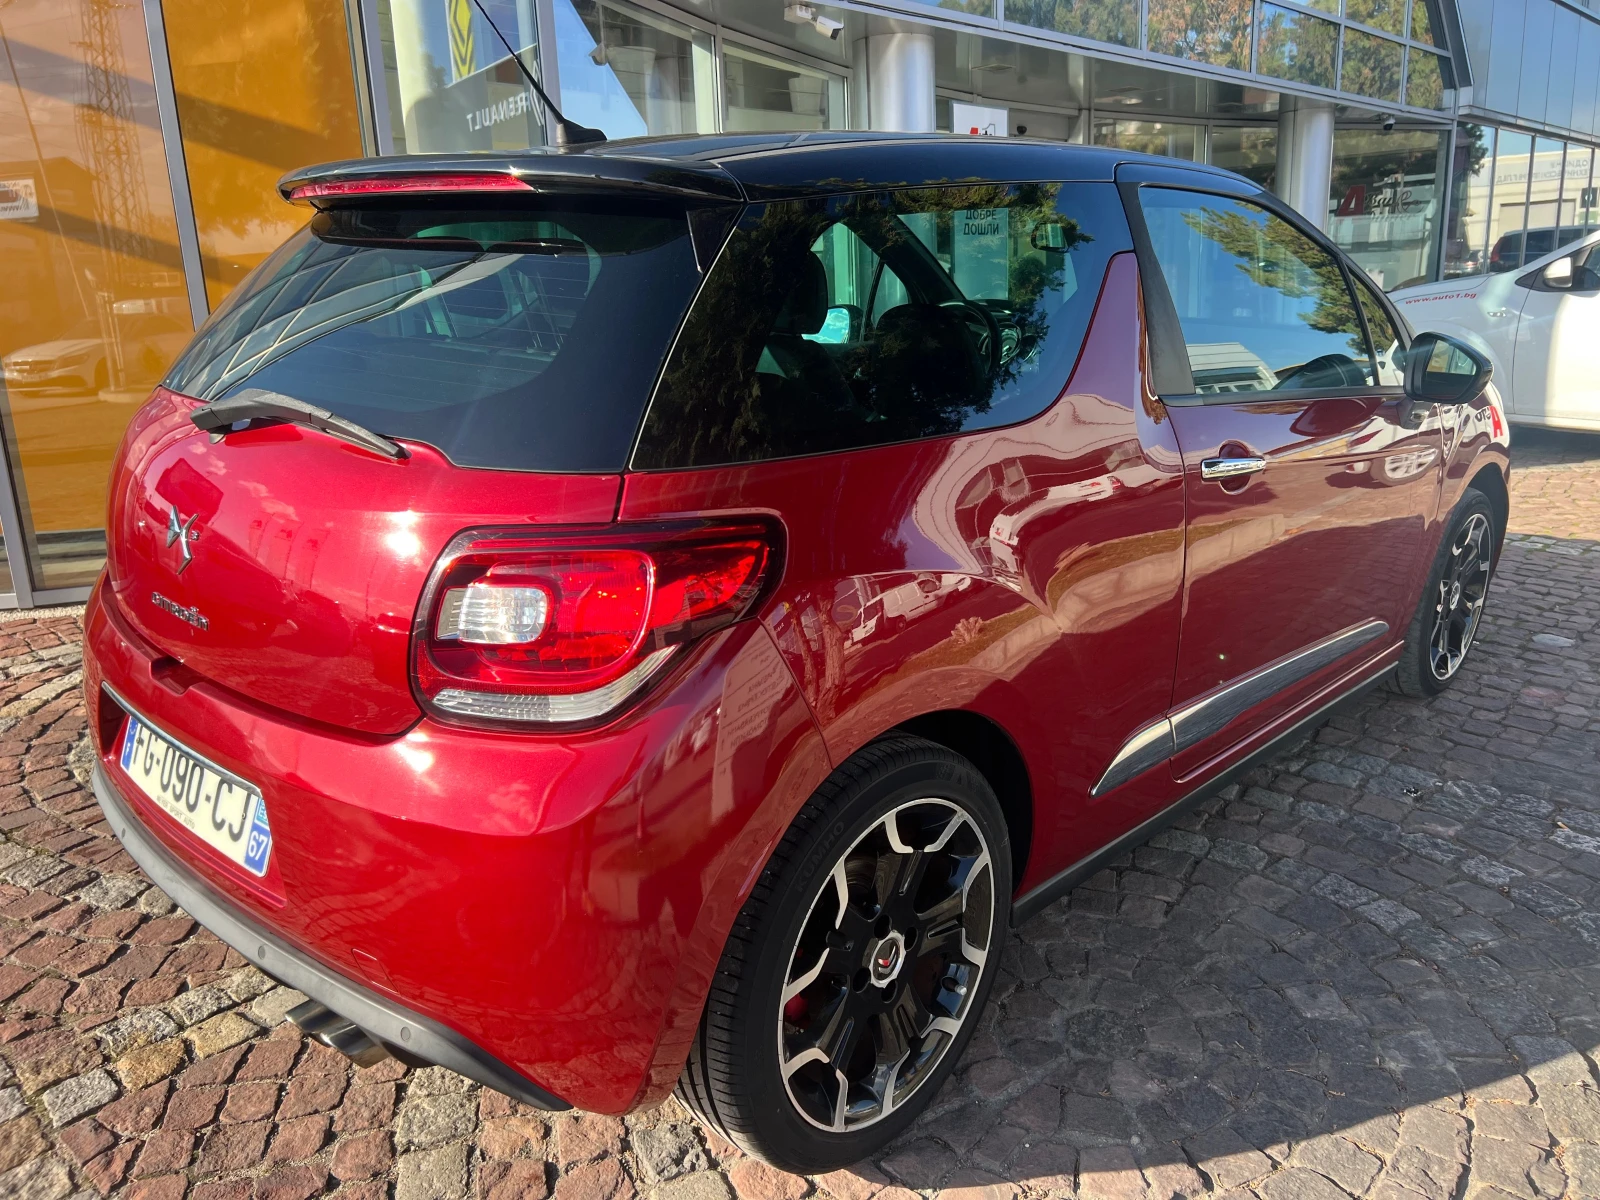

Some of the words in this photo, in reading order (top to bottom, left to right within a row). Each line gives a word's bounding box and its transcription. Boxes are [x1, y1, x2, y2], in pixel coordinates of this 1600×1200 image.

[965, 209, 997, 220] ДОБРЕ
[963, 222, 999, 235] ДОШЛИ
[1405, 292, 1477, 304] www.auto1.bg
[247, 830, 268, 860] 67
